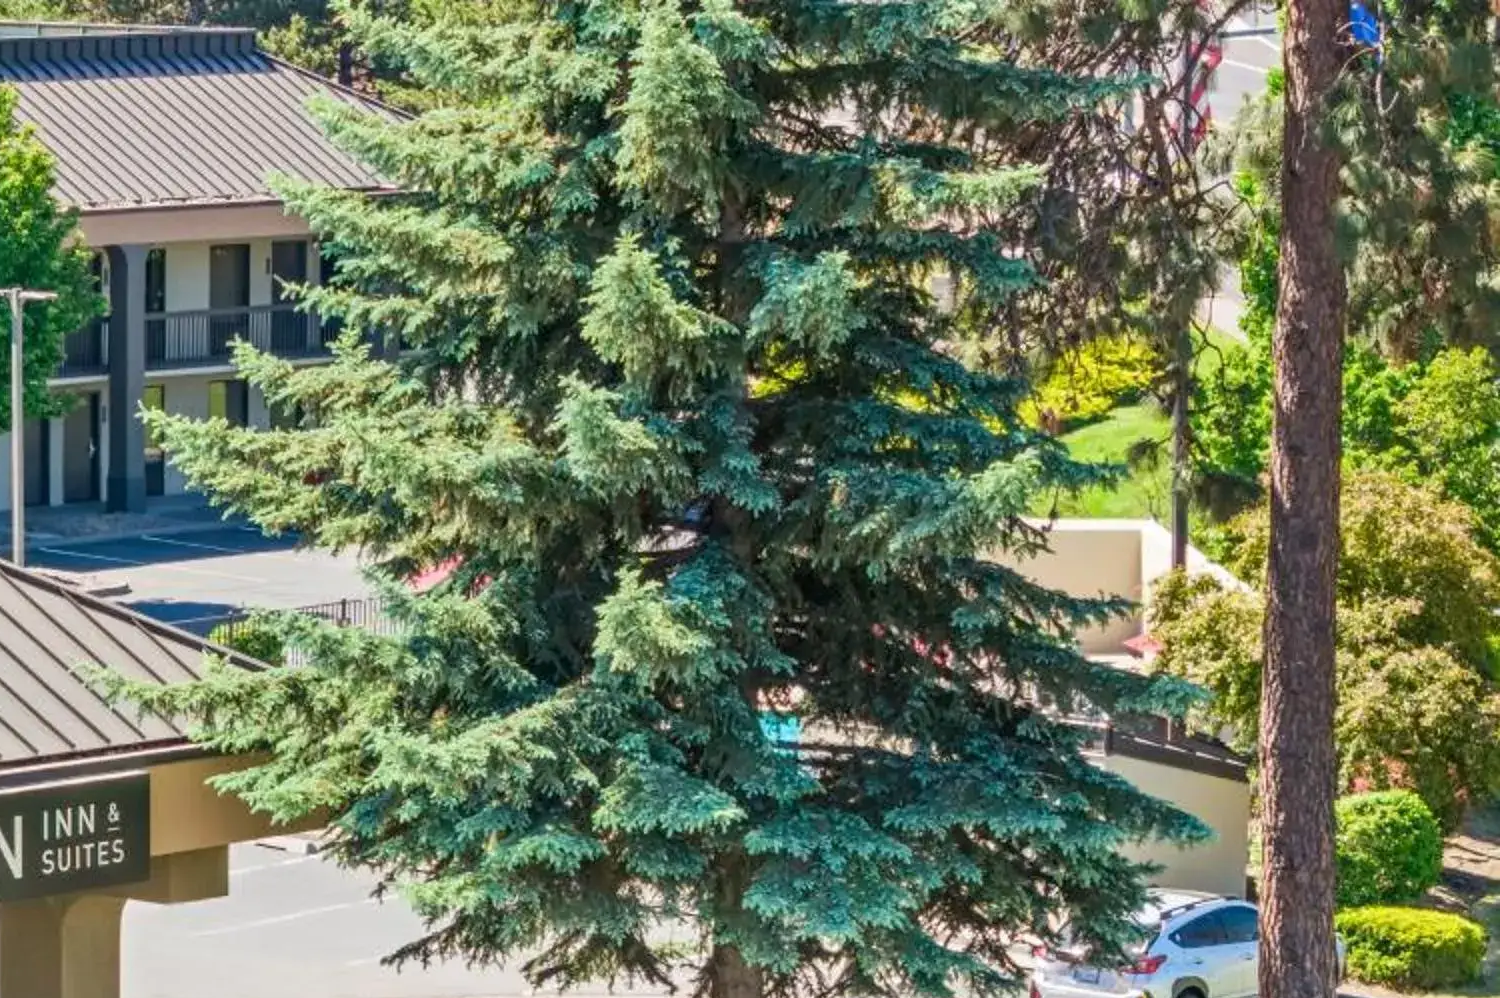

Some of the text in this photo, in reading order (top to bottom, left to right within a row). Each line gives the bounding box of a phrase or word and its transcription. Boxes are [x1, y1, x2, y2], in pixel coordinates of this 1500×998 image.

[43, 802, 120, 841] INN &
[41, 839, 125, 874] SUITES
